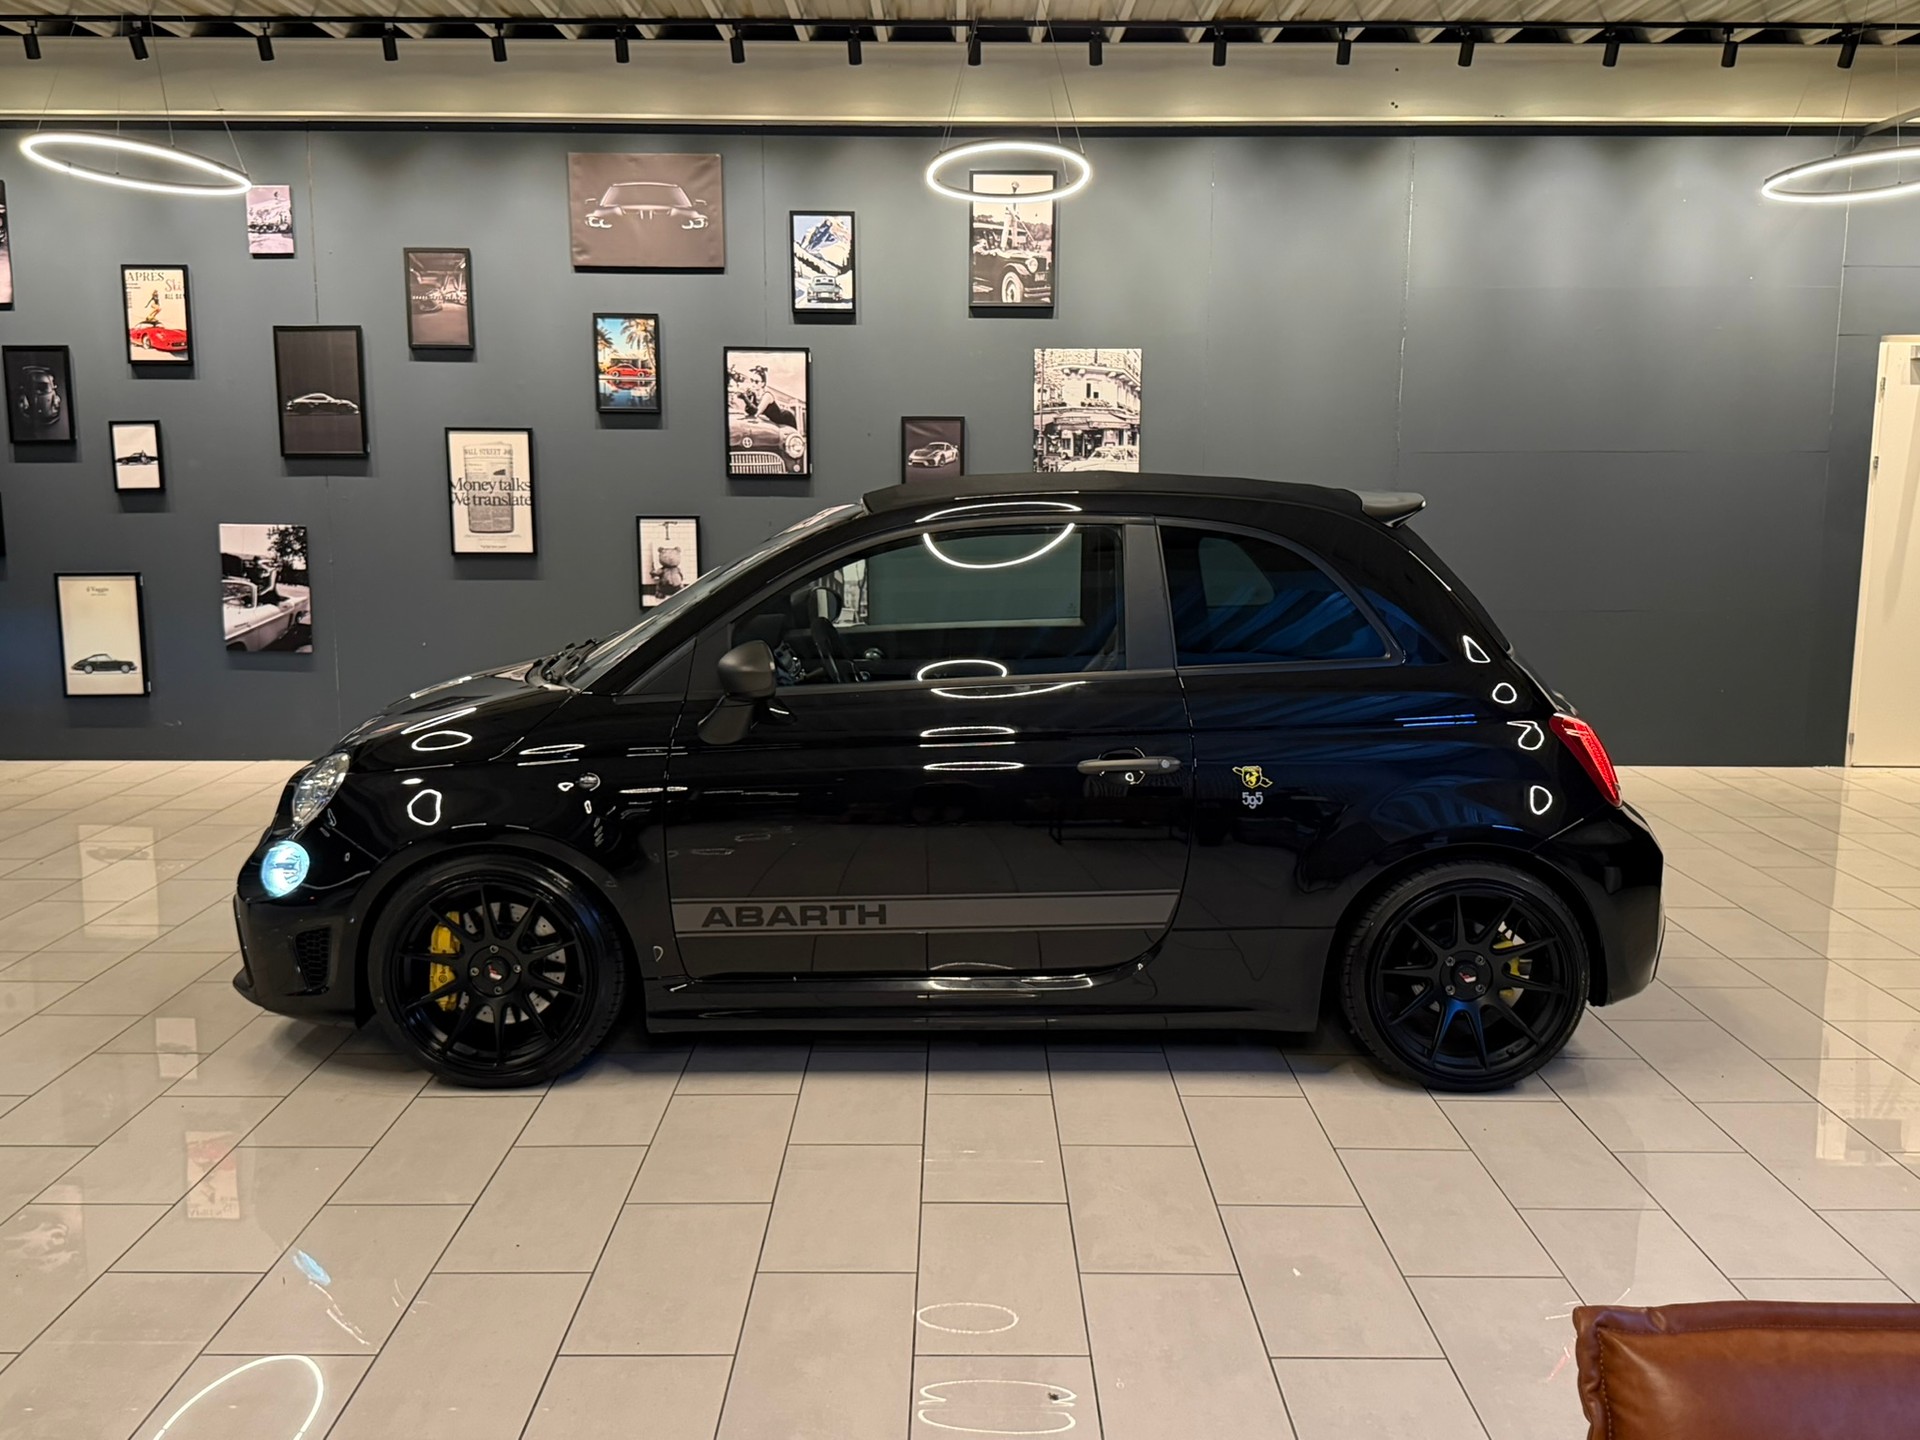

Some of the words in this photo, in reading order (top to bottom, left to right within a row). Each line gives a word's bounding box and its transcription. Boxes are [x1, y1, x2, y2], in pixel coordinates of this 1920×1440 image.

[499, 477, 531, 491] talks
[472, 492, 532, 506] translate
[1242, 791, 1264, 809] 595
[701, 904, 887, 927] ABARTH
